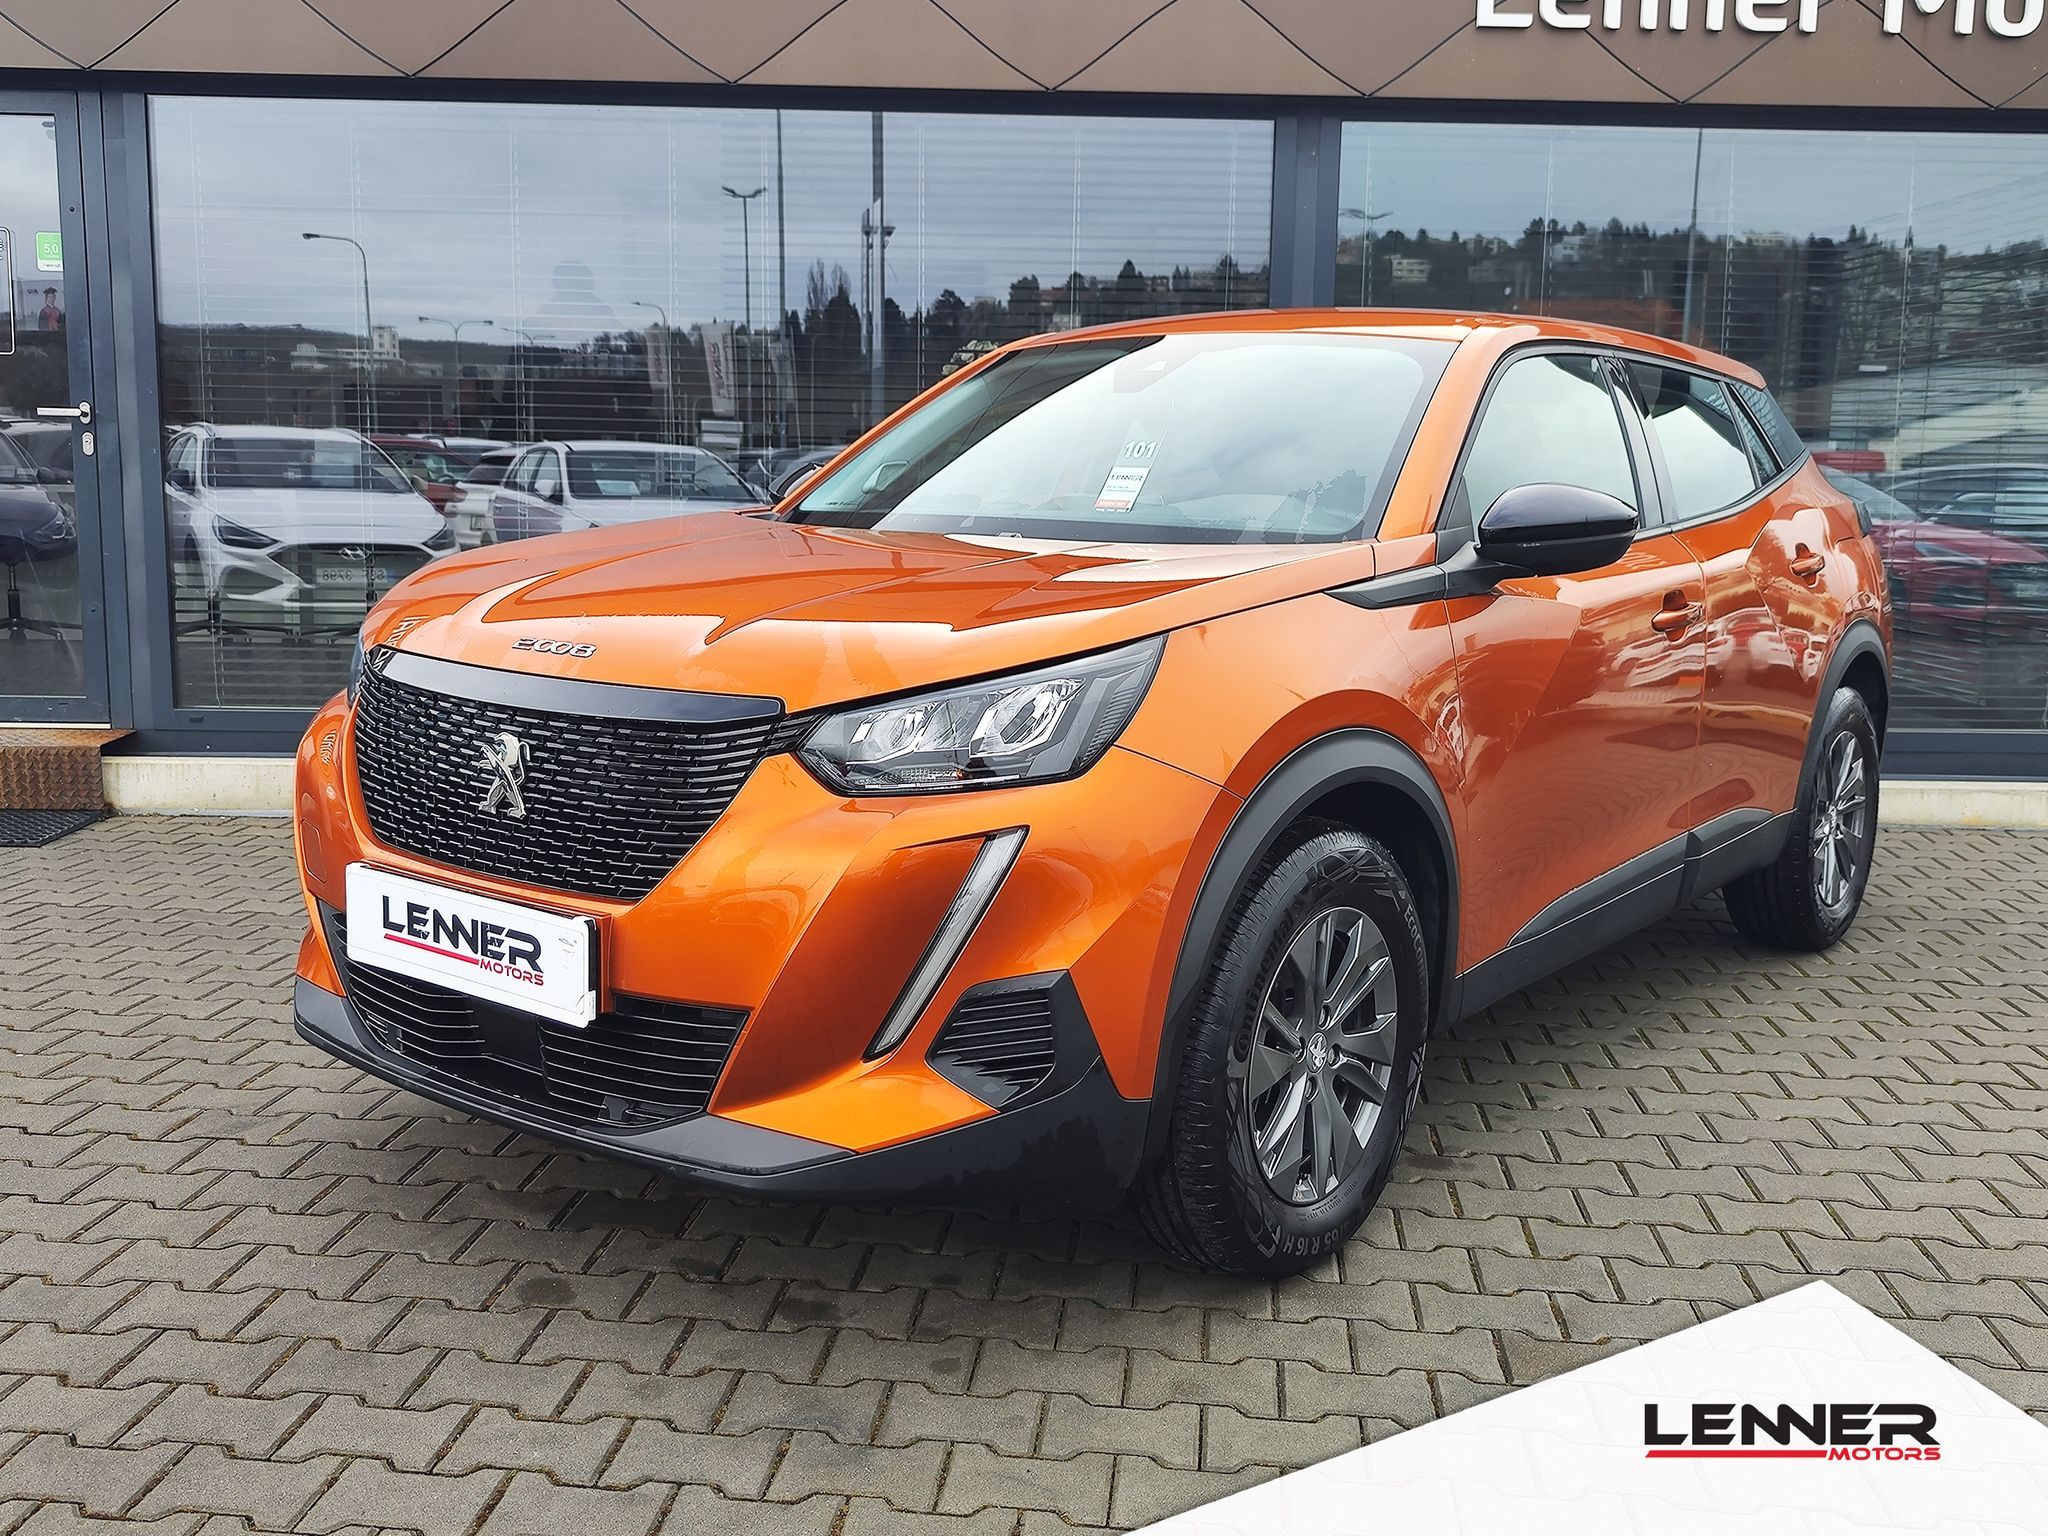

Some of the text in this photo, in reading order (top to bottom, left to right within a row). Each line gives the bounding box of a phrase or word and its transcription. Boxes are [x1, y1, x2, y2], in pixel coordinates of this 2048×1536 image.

[1123, 440, 1157, 459] 101
[512, 637, 597, 658] 2008
[382, 895, 544, 973] LENNER
[479, 958, 545, 986] MOTORS
